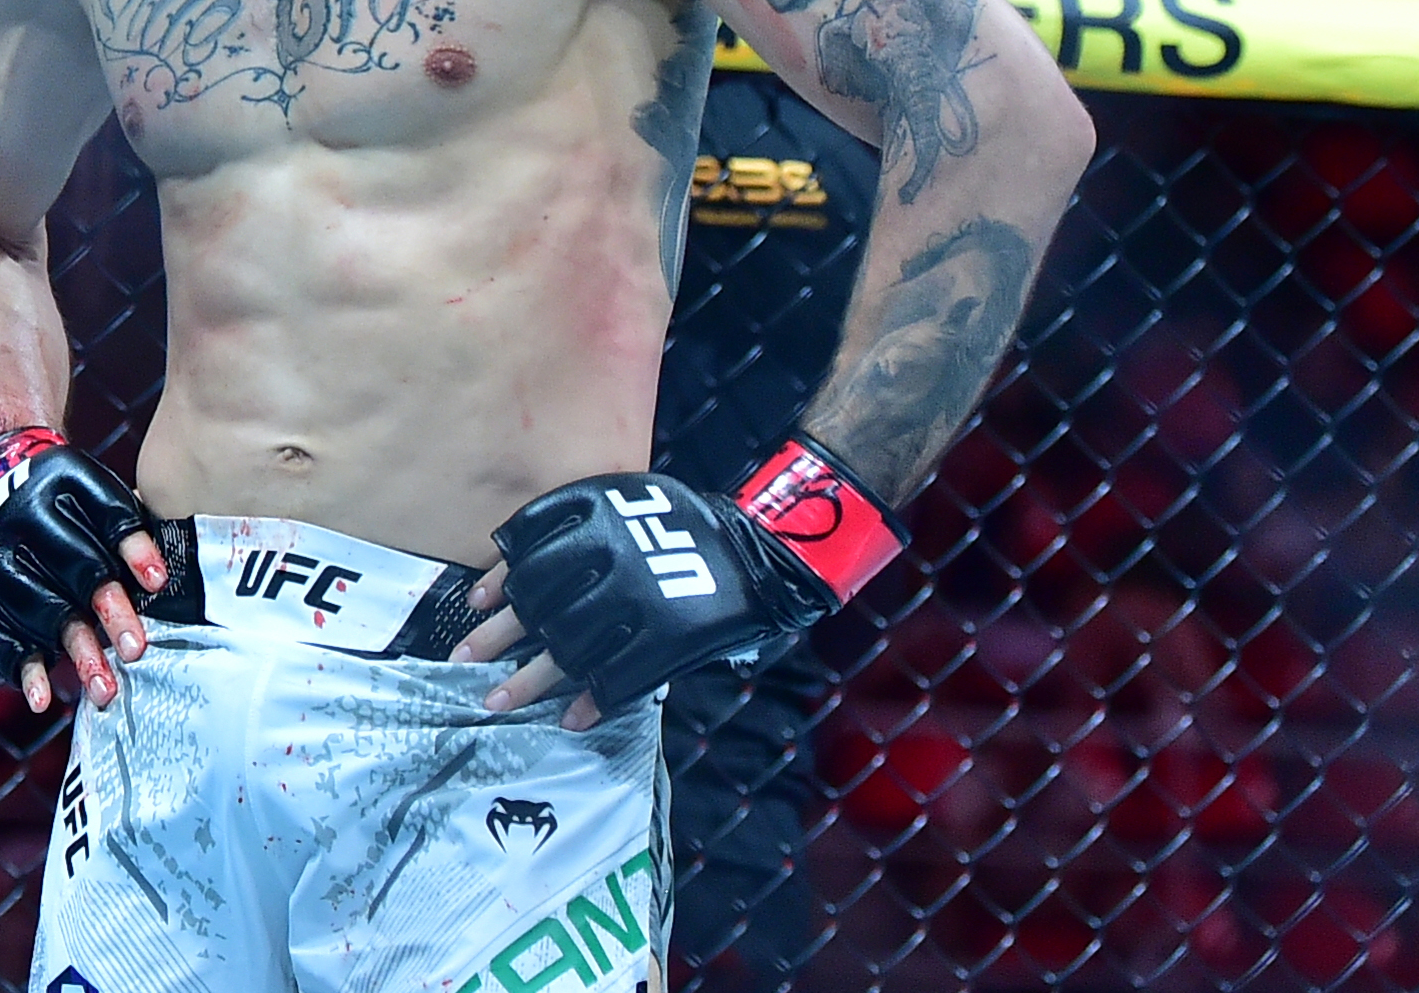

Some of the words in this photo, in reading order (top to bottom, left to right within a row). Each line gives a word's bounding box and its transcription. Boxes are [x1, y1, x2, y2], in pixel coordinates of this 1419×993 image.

[235, 549, 363, 615] UFC
[604, 484, 717, 600] UFC
[62, 762, 90, 880] UFC
